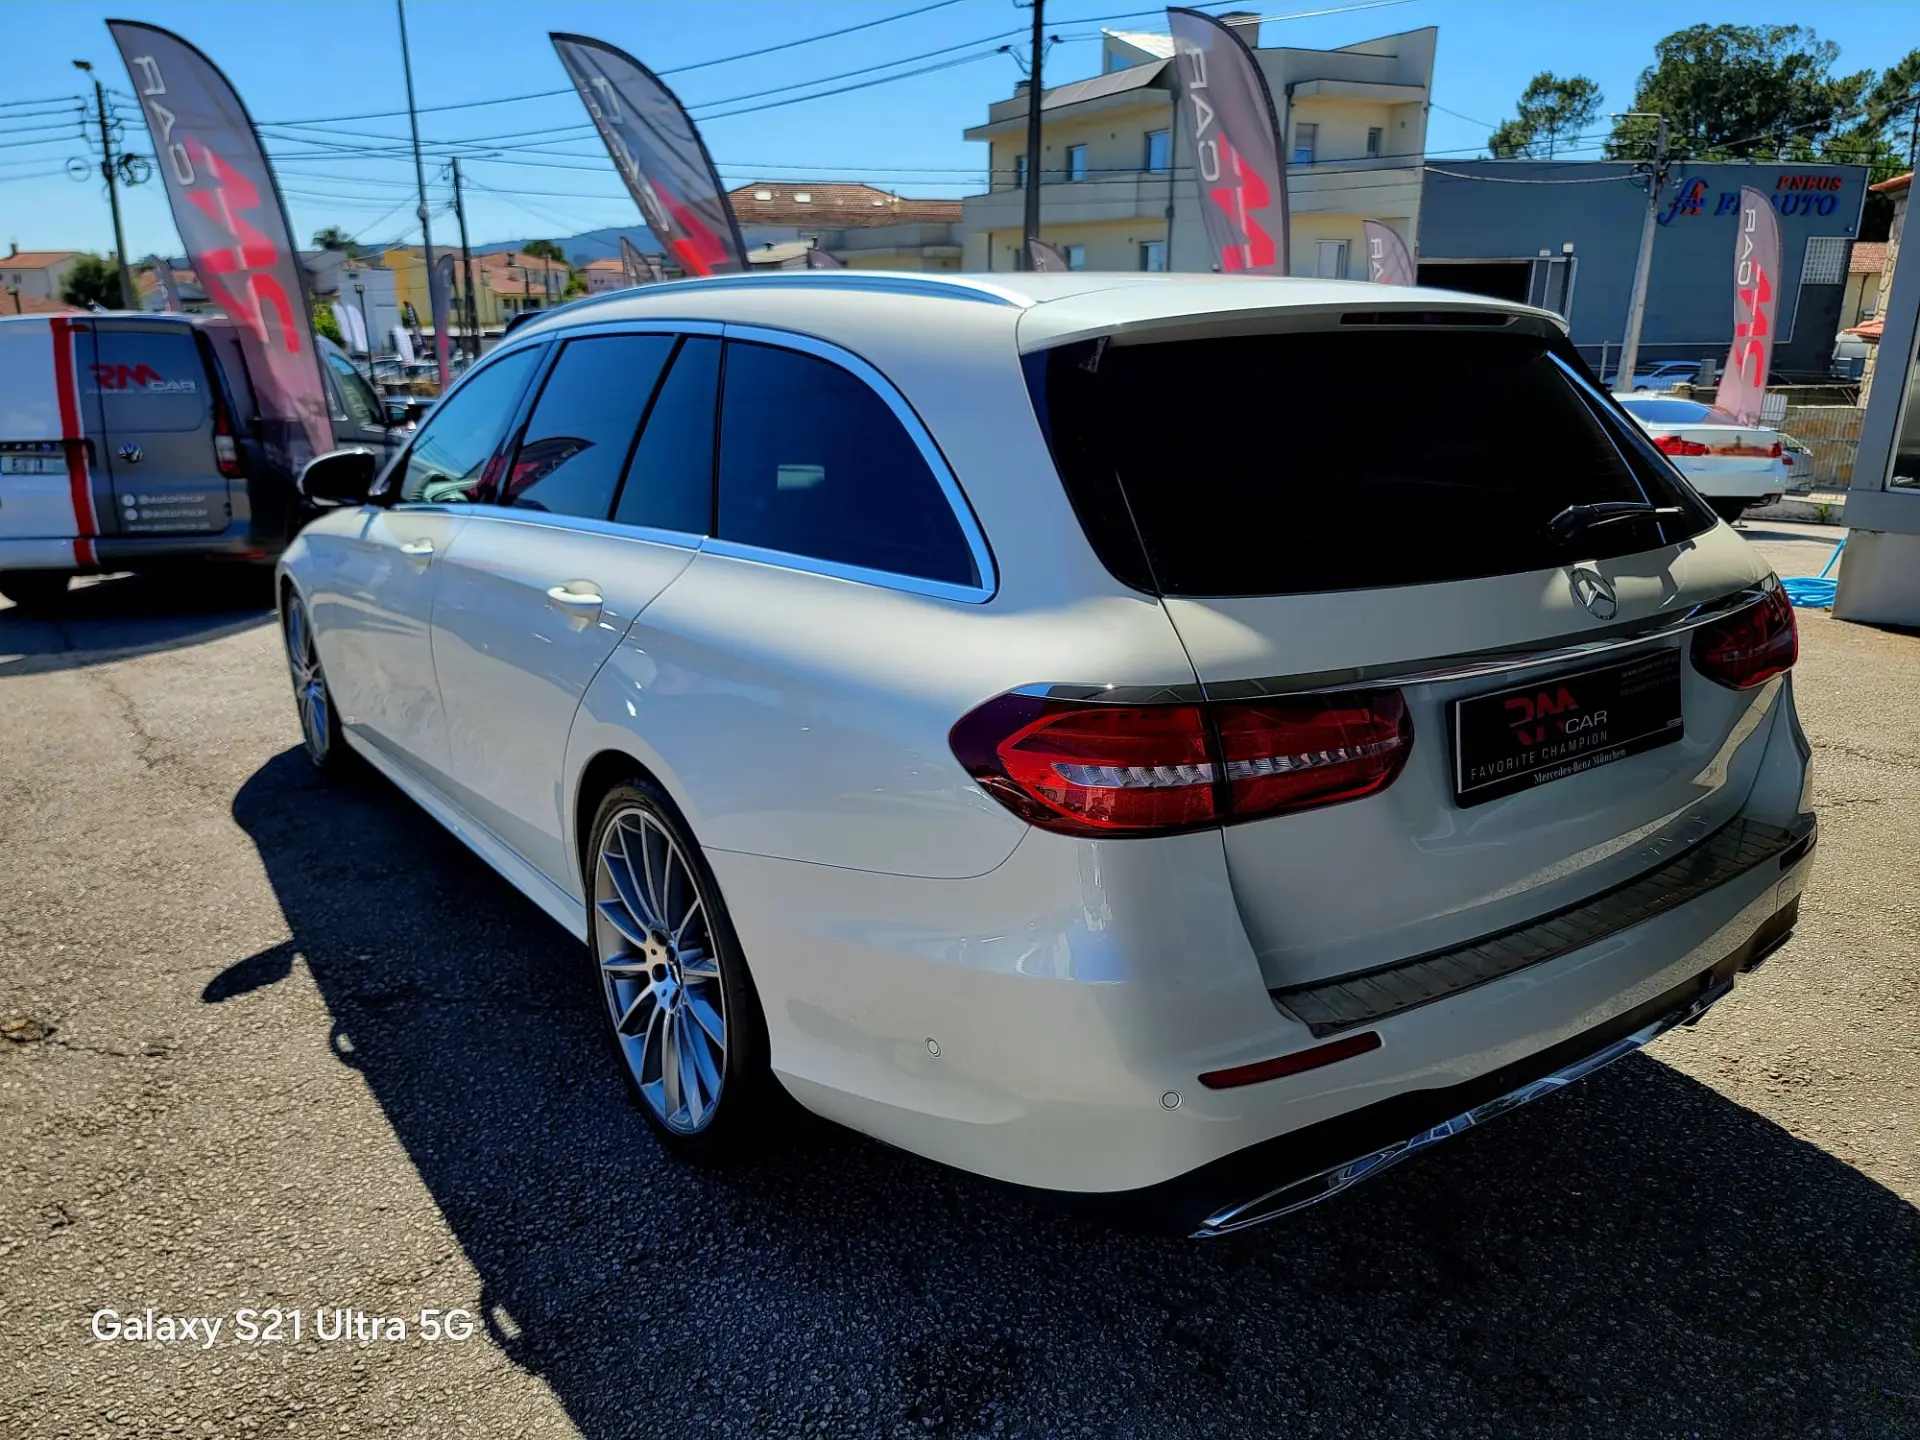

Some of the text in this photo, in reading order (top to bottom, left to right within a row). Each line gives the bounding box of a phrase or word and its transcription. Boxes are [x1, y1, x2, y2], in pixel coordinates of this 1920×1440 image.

[1565, 710, 1608, 734] CAR
[1470, 730, 1608, 781] FAVORITE CHAMPION
[1533, 748, 1627, 785] Mercedes-Benz München
